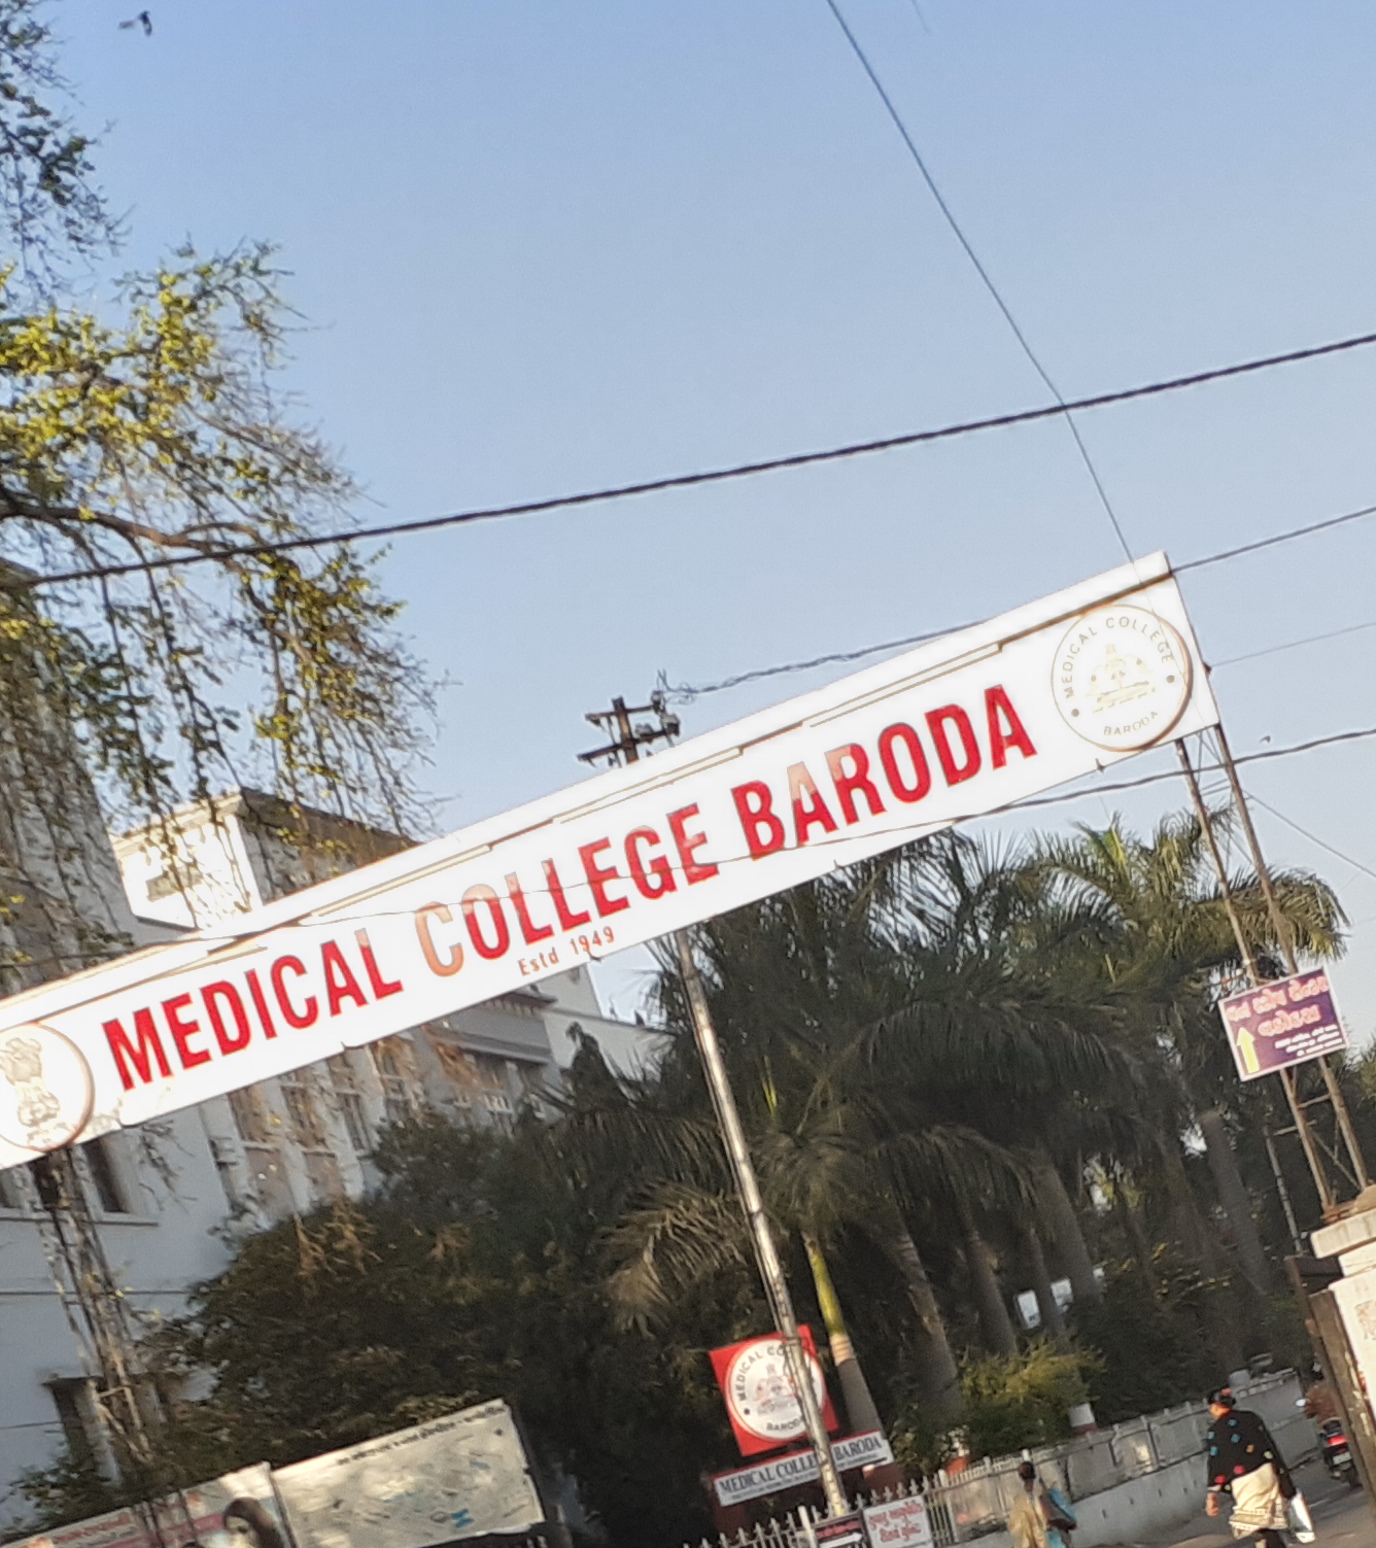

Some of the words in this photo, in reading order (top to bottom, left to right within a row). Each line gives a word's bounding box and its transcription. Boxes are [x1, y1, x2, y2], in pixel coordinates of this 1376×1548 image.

[1061, 627, 1097, 699] MEDICAL
[1106, 616, 1175, 663] COLLEGE
[1104, 711, 1158, 736] BARODA
[101, 931, 405, 1093] MEDICAL
[413, 803, 720, 977] COLLEGE
[731, 684, 1039, 864] BARODA
[517, 946, 560, 976] Estd
[569, 925, 615, 955] 1949
[735, 1351, 763, 1401] MEDICAL
[719, 1468, 774, 1493] MEDICAL
[833, 1435, 883, 1460] BARODA
